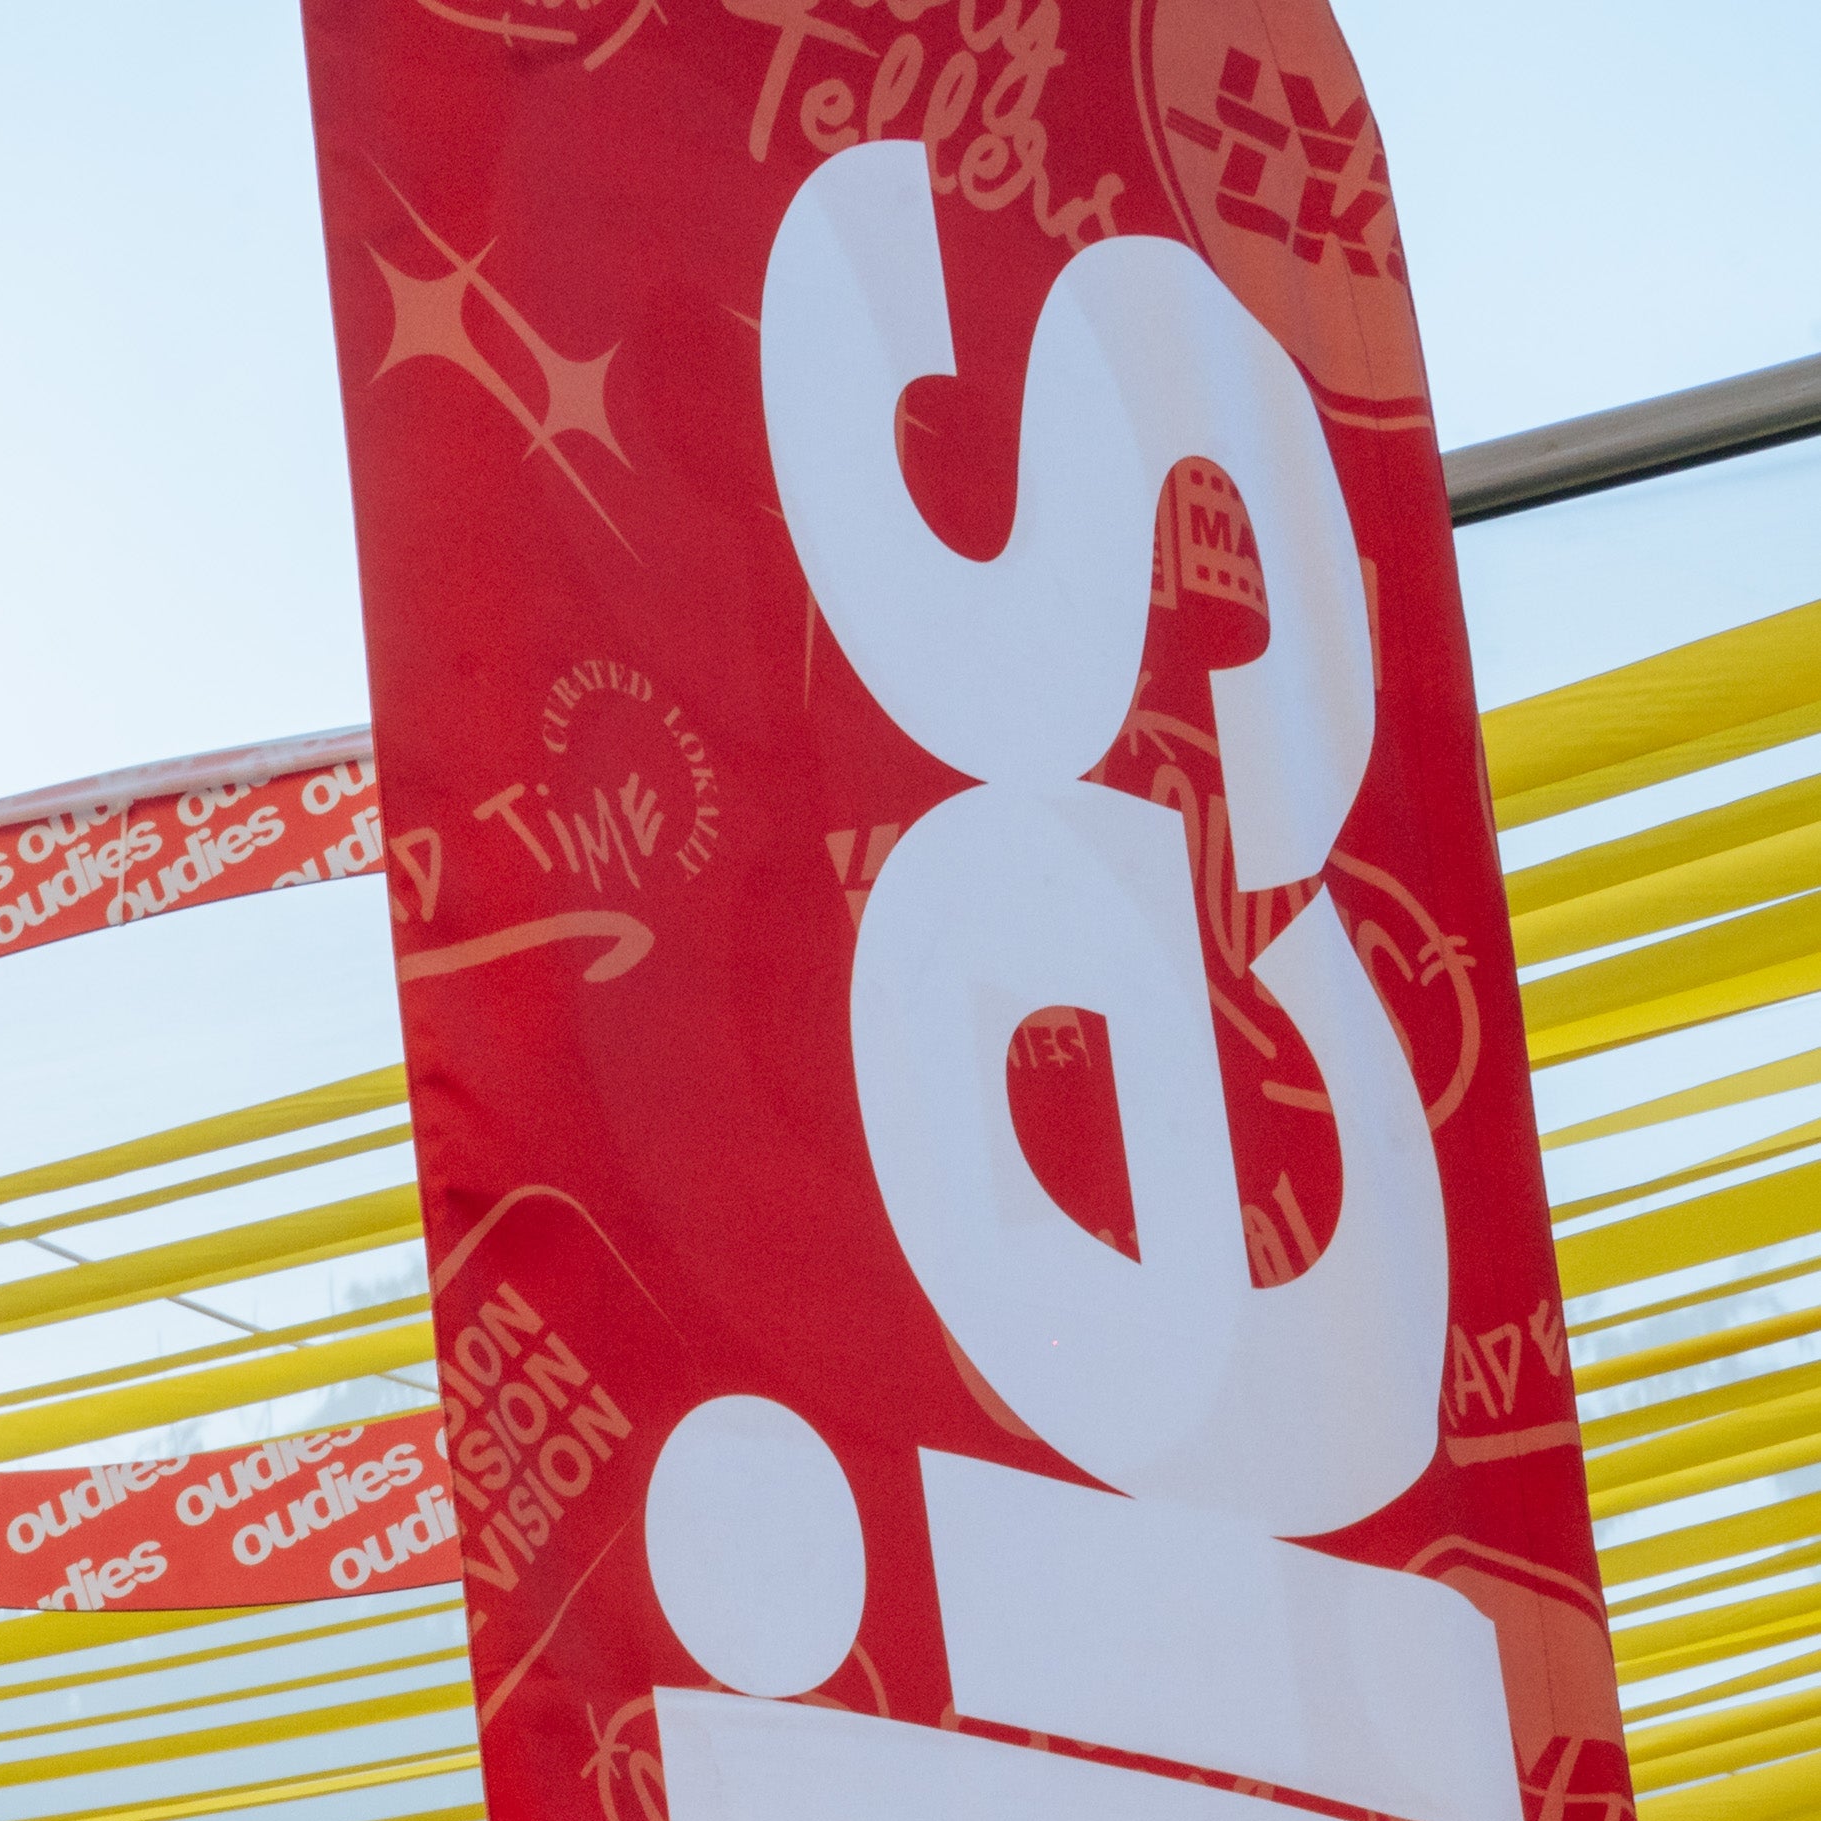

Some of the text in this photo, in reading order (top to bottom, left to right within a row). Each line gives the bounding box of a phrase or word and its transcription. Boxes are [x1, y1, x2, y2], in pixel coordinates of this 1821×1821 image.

[542, 659, 652, 754] CURATED
[106, 805, 286, 925] oudies
[1443, 1300, 1567, 1428] ADE
[454, 1332, 589, 1534] ISION
[464, 1384, 633, 1592] VISION
[232, 1443, 423, 1566] oudies
